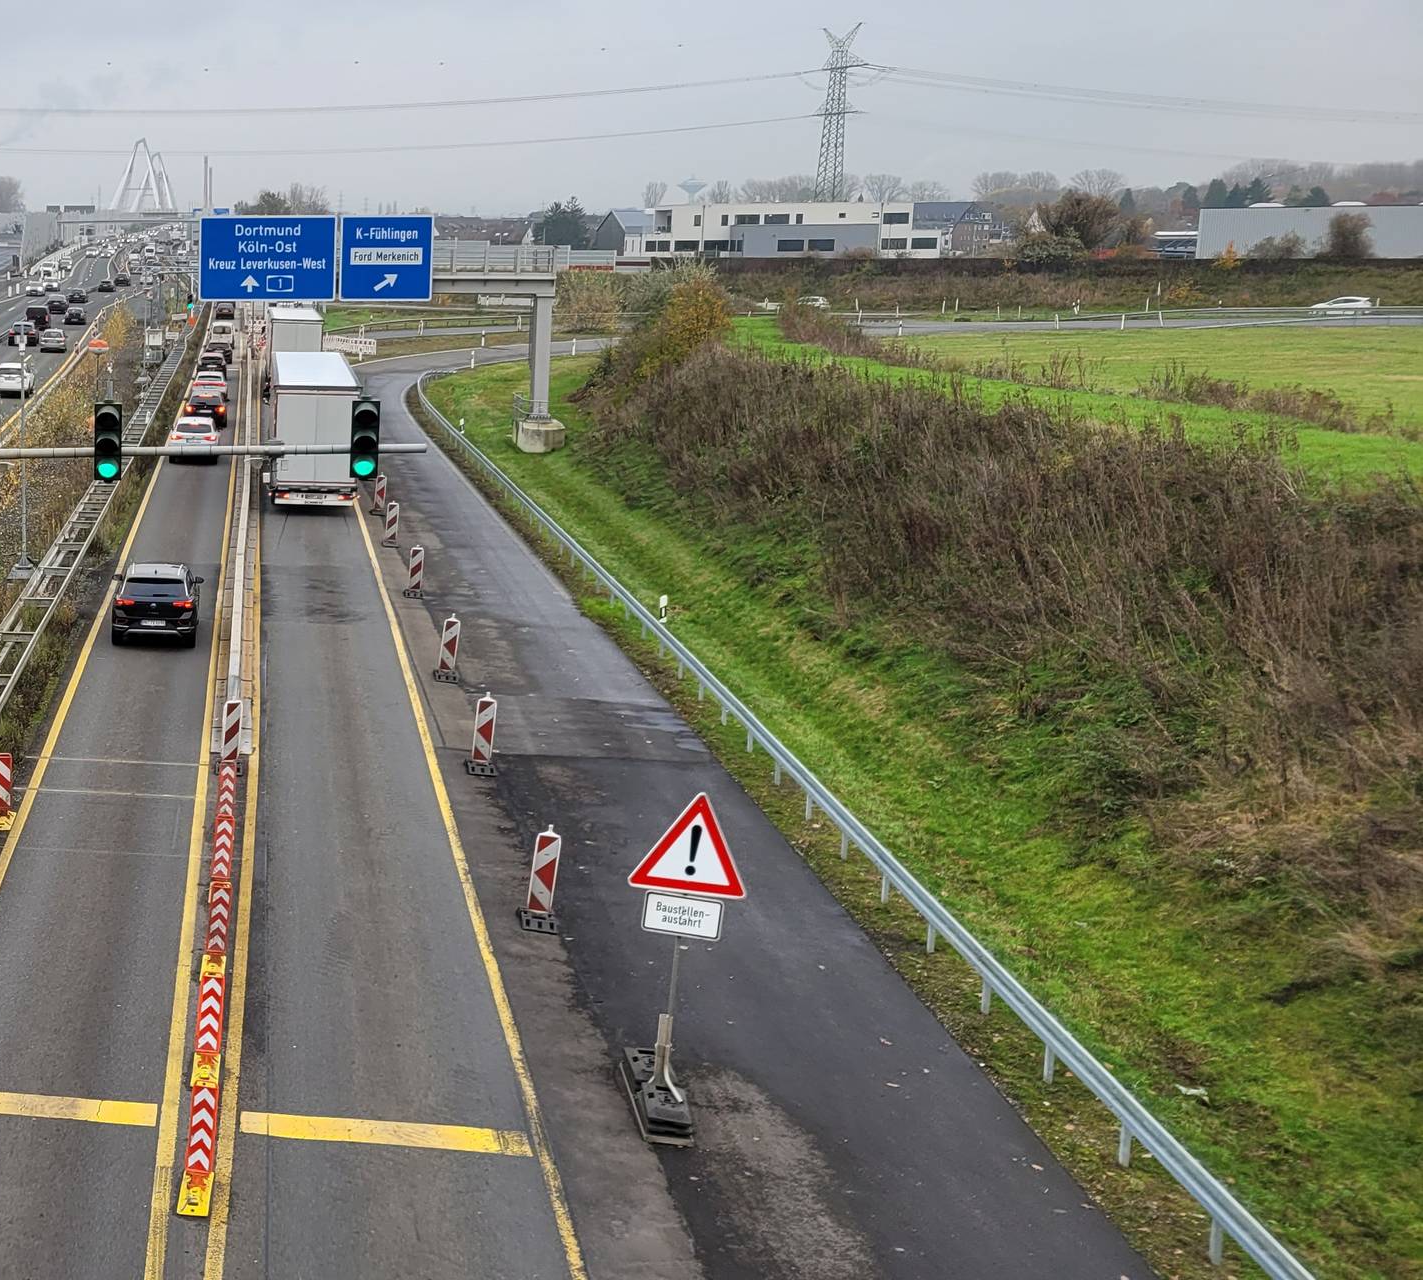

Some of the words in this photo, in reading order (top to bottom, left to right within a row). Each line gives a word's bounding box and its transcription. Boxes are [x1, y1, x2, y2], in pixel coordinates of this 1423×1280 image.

[235, 223, 302, 237] Dortmund
[355, 227, 419, 242] K-Fühlingen
[238, 240, 298, 254] Köln-Ost
[208, 257, 236, 270] Kreuz
[240, 257, 327, 270] Leverkusen-West
[353, 251, 372, 262] Ford
[375, 251, 419, 262] Merkenich
[656, 902, 710, 918] Baustellen-
[661, 915, 701, 928] ausfahrt
